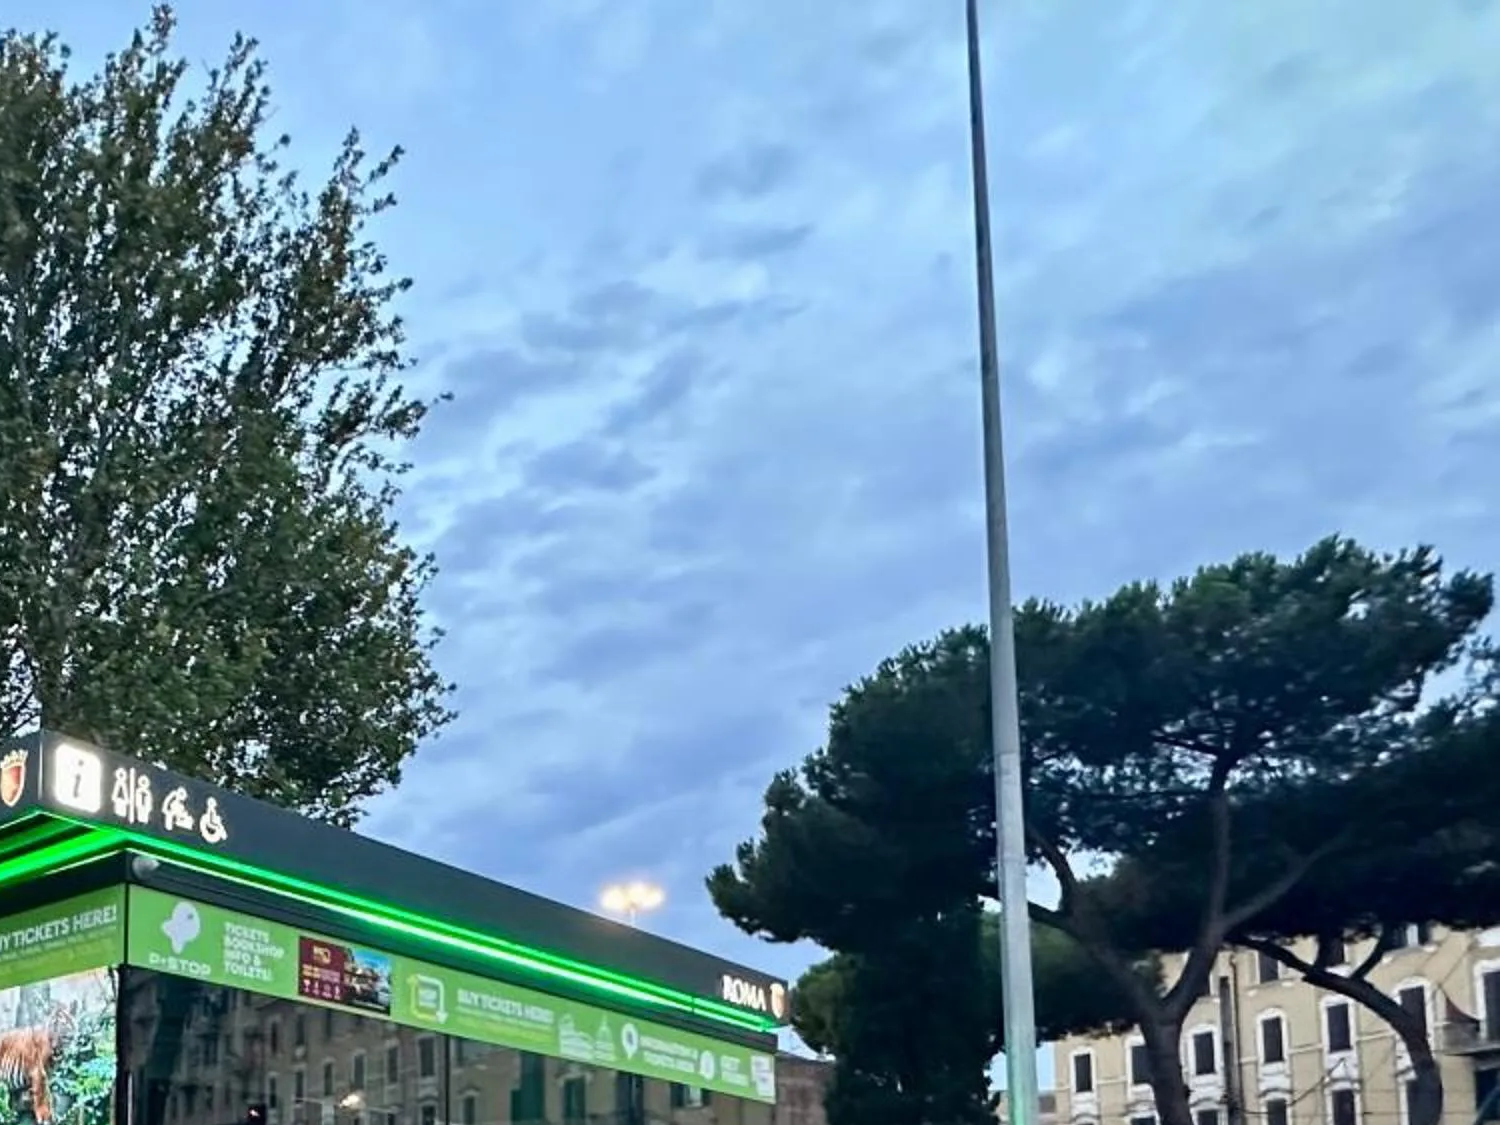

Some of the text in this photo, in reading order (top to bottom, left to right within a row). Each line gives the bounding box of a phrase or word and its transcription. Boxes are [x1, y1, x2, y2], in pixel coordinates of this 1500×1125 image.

[12, 917, 70, 947] TICKETS
[72, 904, 117, 931] HERE!
[723, 974, 767, 1012] ROMA
